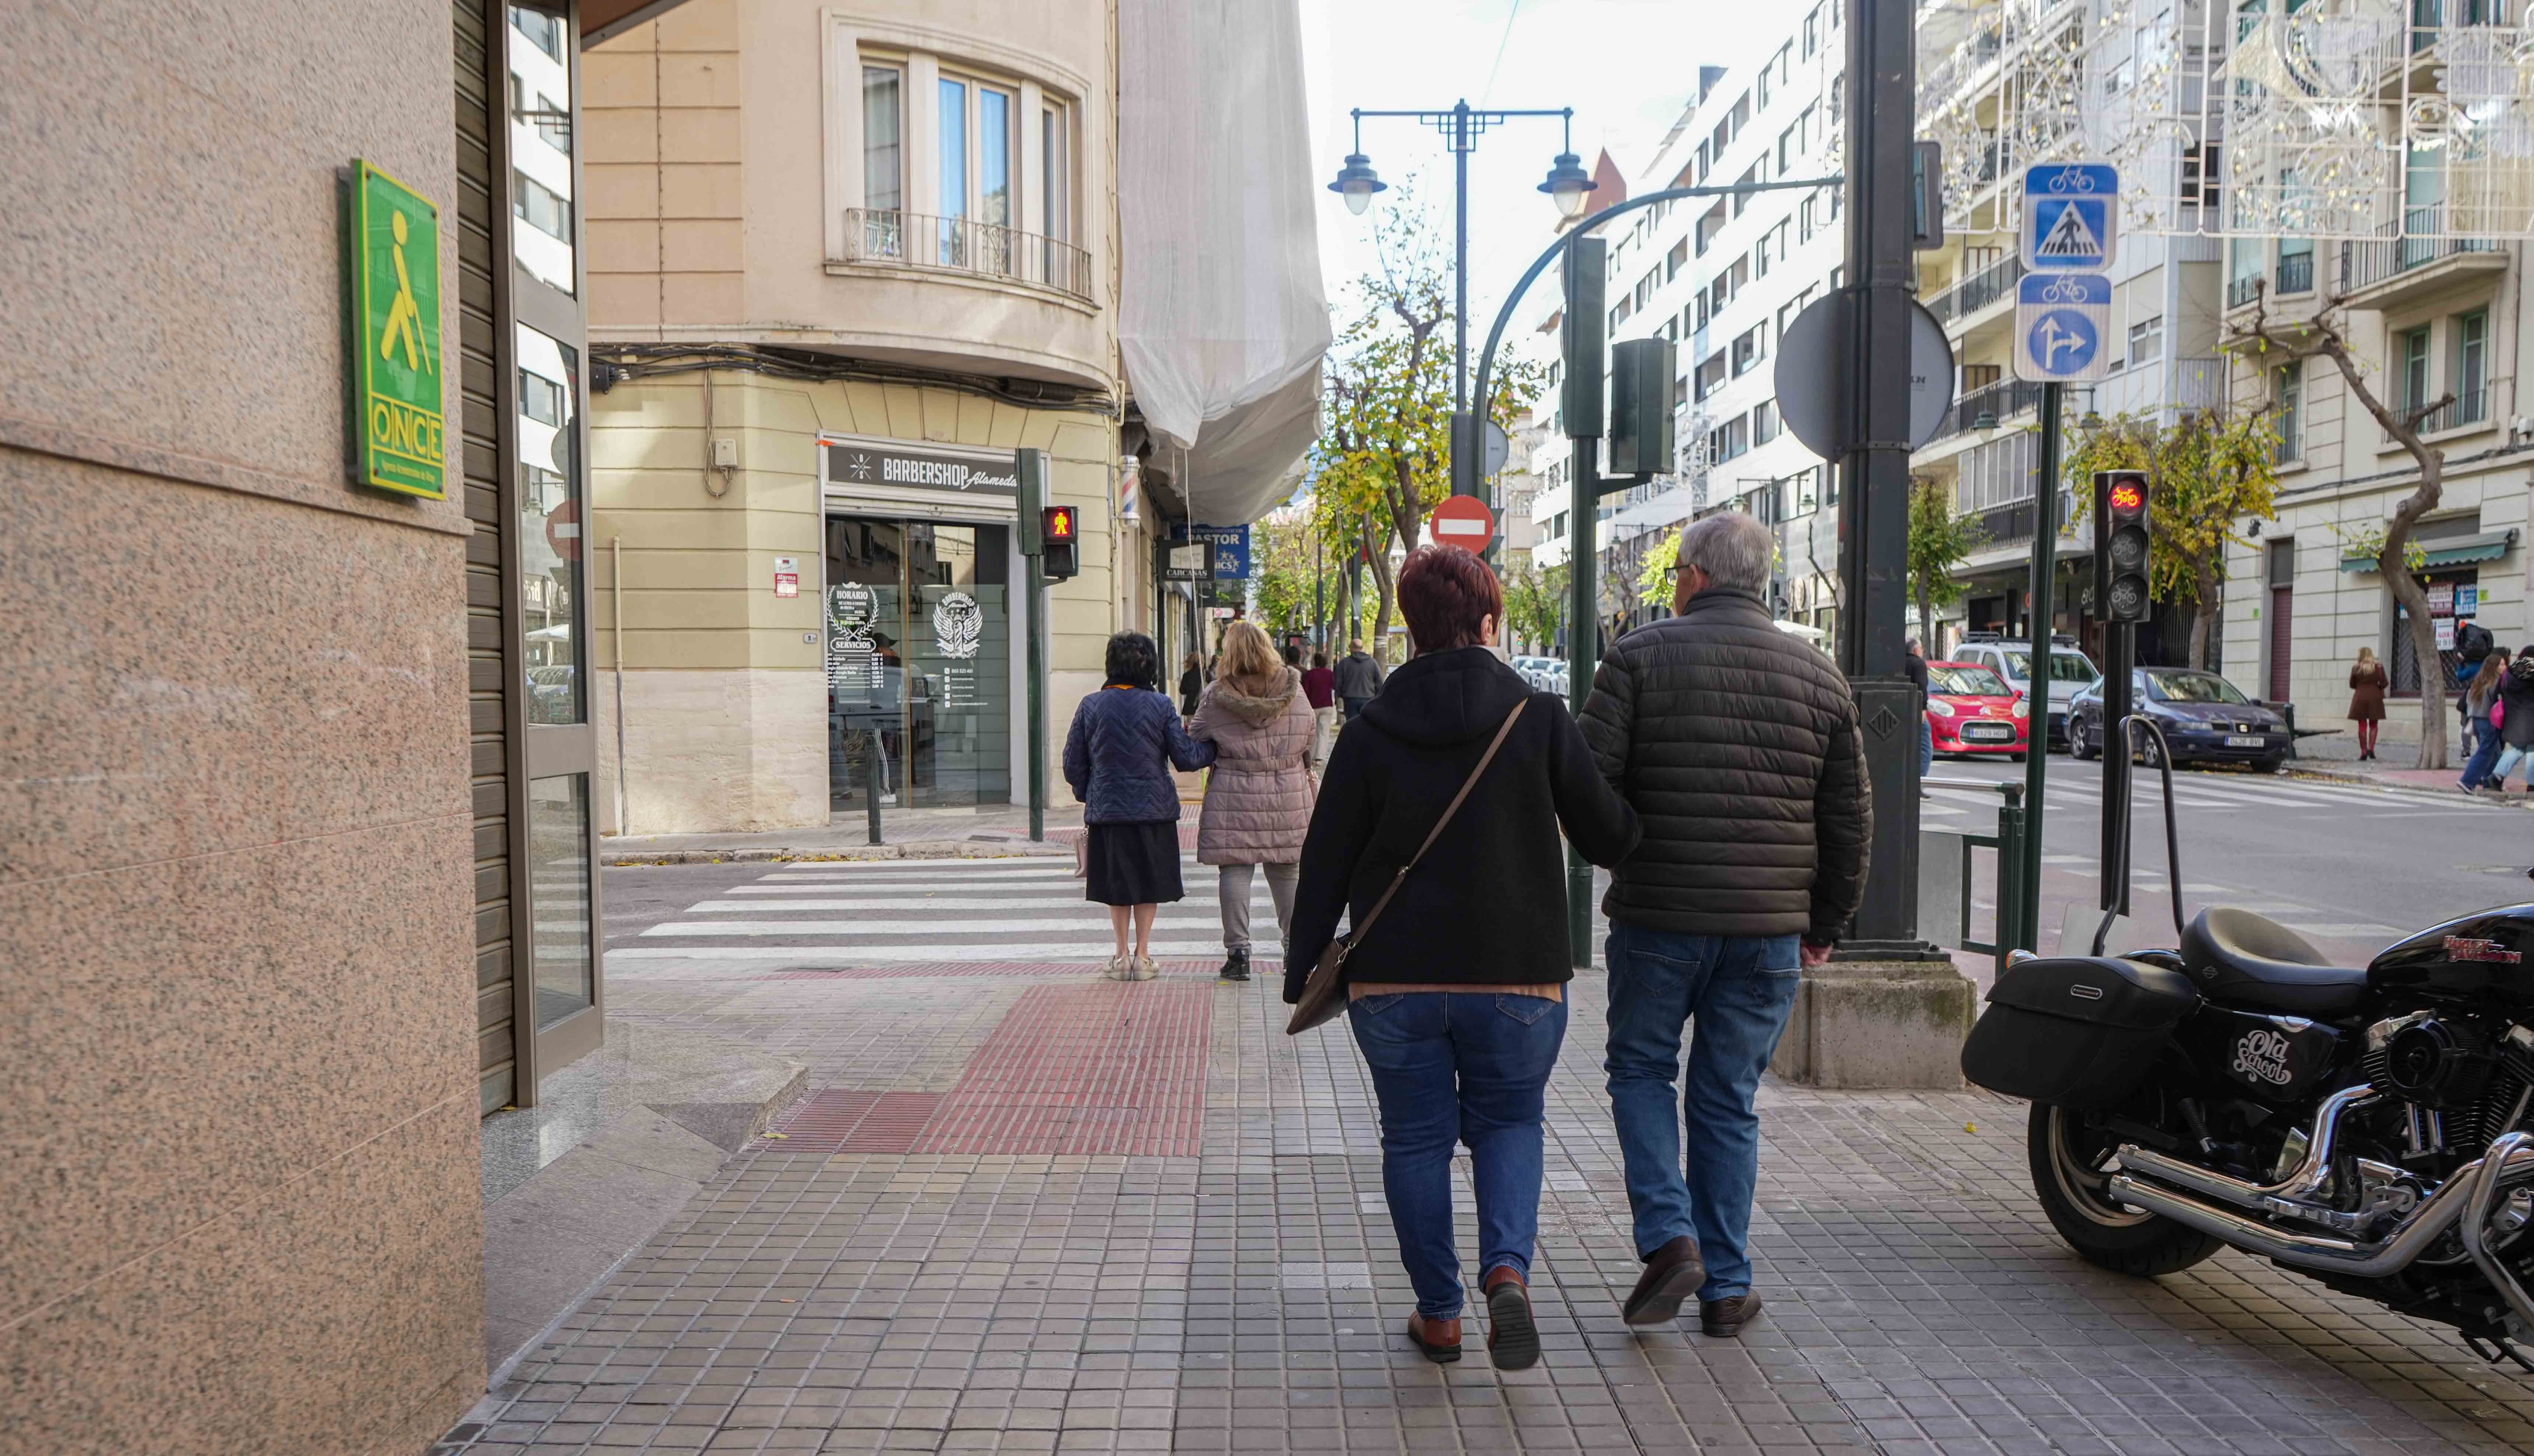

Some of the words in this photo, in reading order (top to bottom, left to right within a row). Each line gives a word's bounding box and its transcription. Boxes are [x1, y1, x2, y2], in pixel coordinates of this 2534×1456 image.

[374, 402, 441, 460] ONCE
[883, 458, 969, 490] BARBERSHOP
[962, 471, 1017, 488] Alameda
[836, 590, 868, 600] HORARIO
[942, 592, 975, 607] BARBERSHOP
[2233, 1038, 2292, 1085] School
[2248, 1030, 2291, 1063] Old
